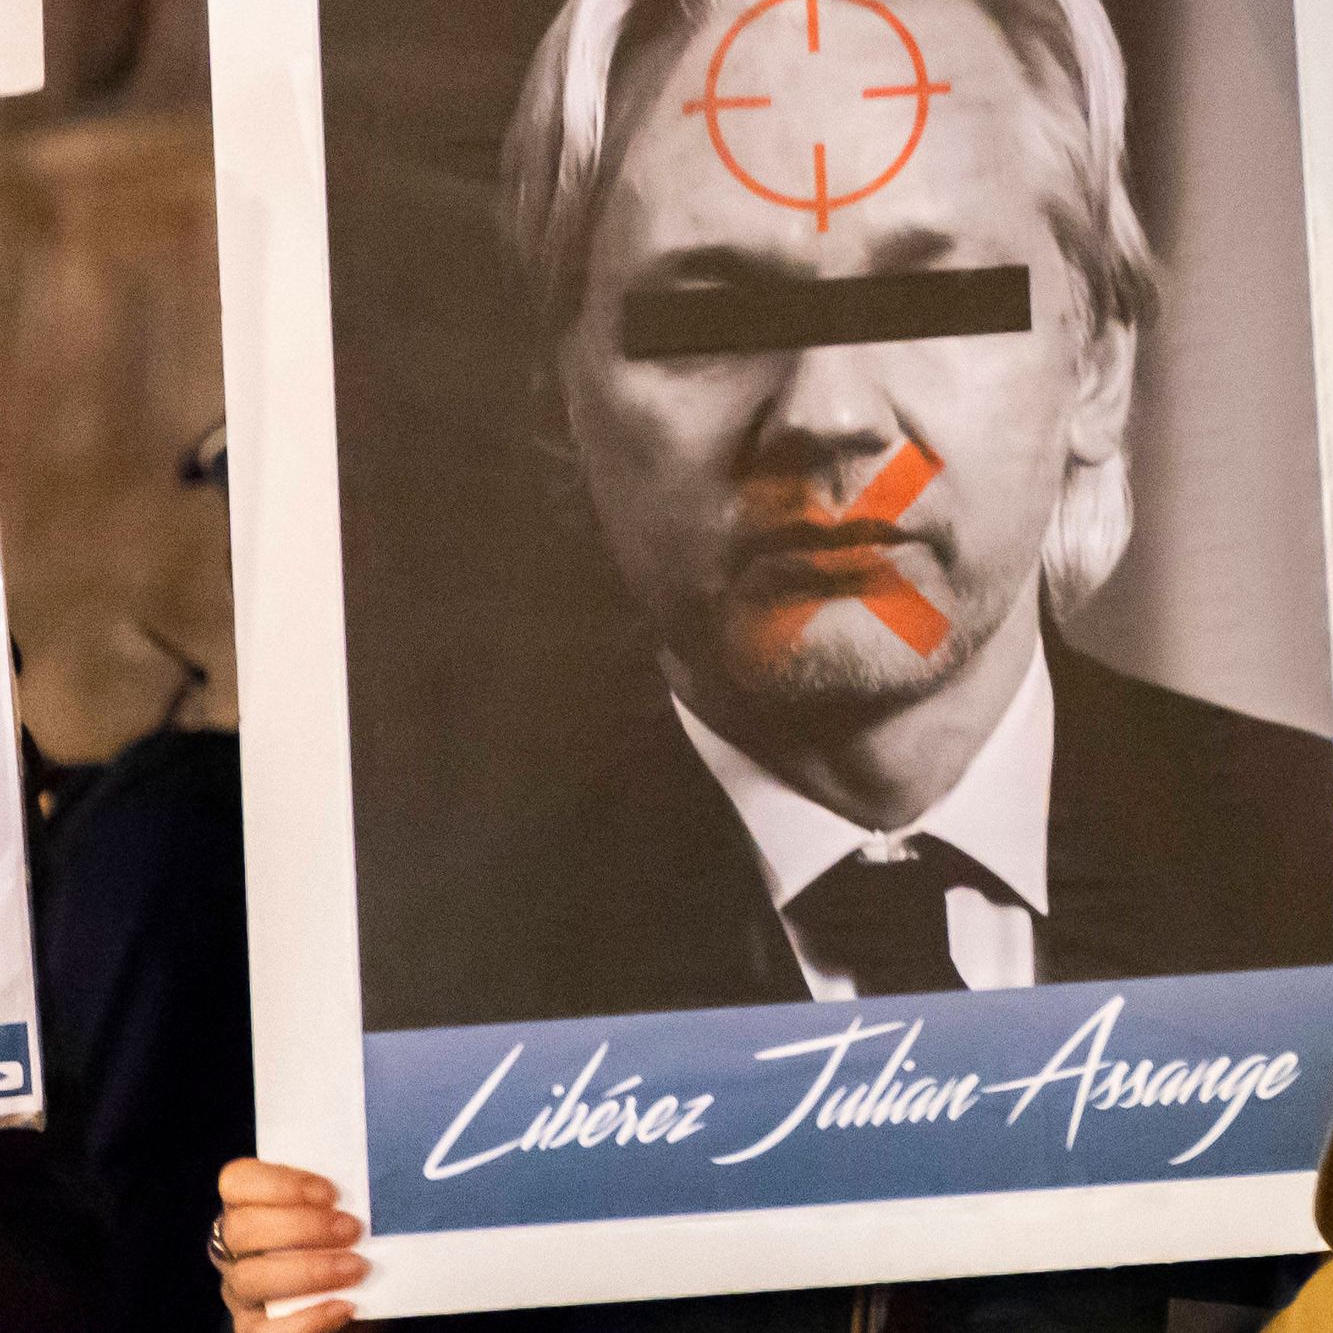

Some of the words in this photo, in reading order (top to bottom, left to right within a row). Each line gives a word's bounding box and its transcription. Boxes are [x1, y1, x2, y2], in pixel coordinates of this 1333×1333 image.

[424, 1041, 715, 1182] Libérez
[711, 1015, 982, 1165] Julian
[982, 995, 1302, 1166] Assange
